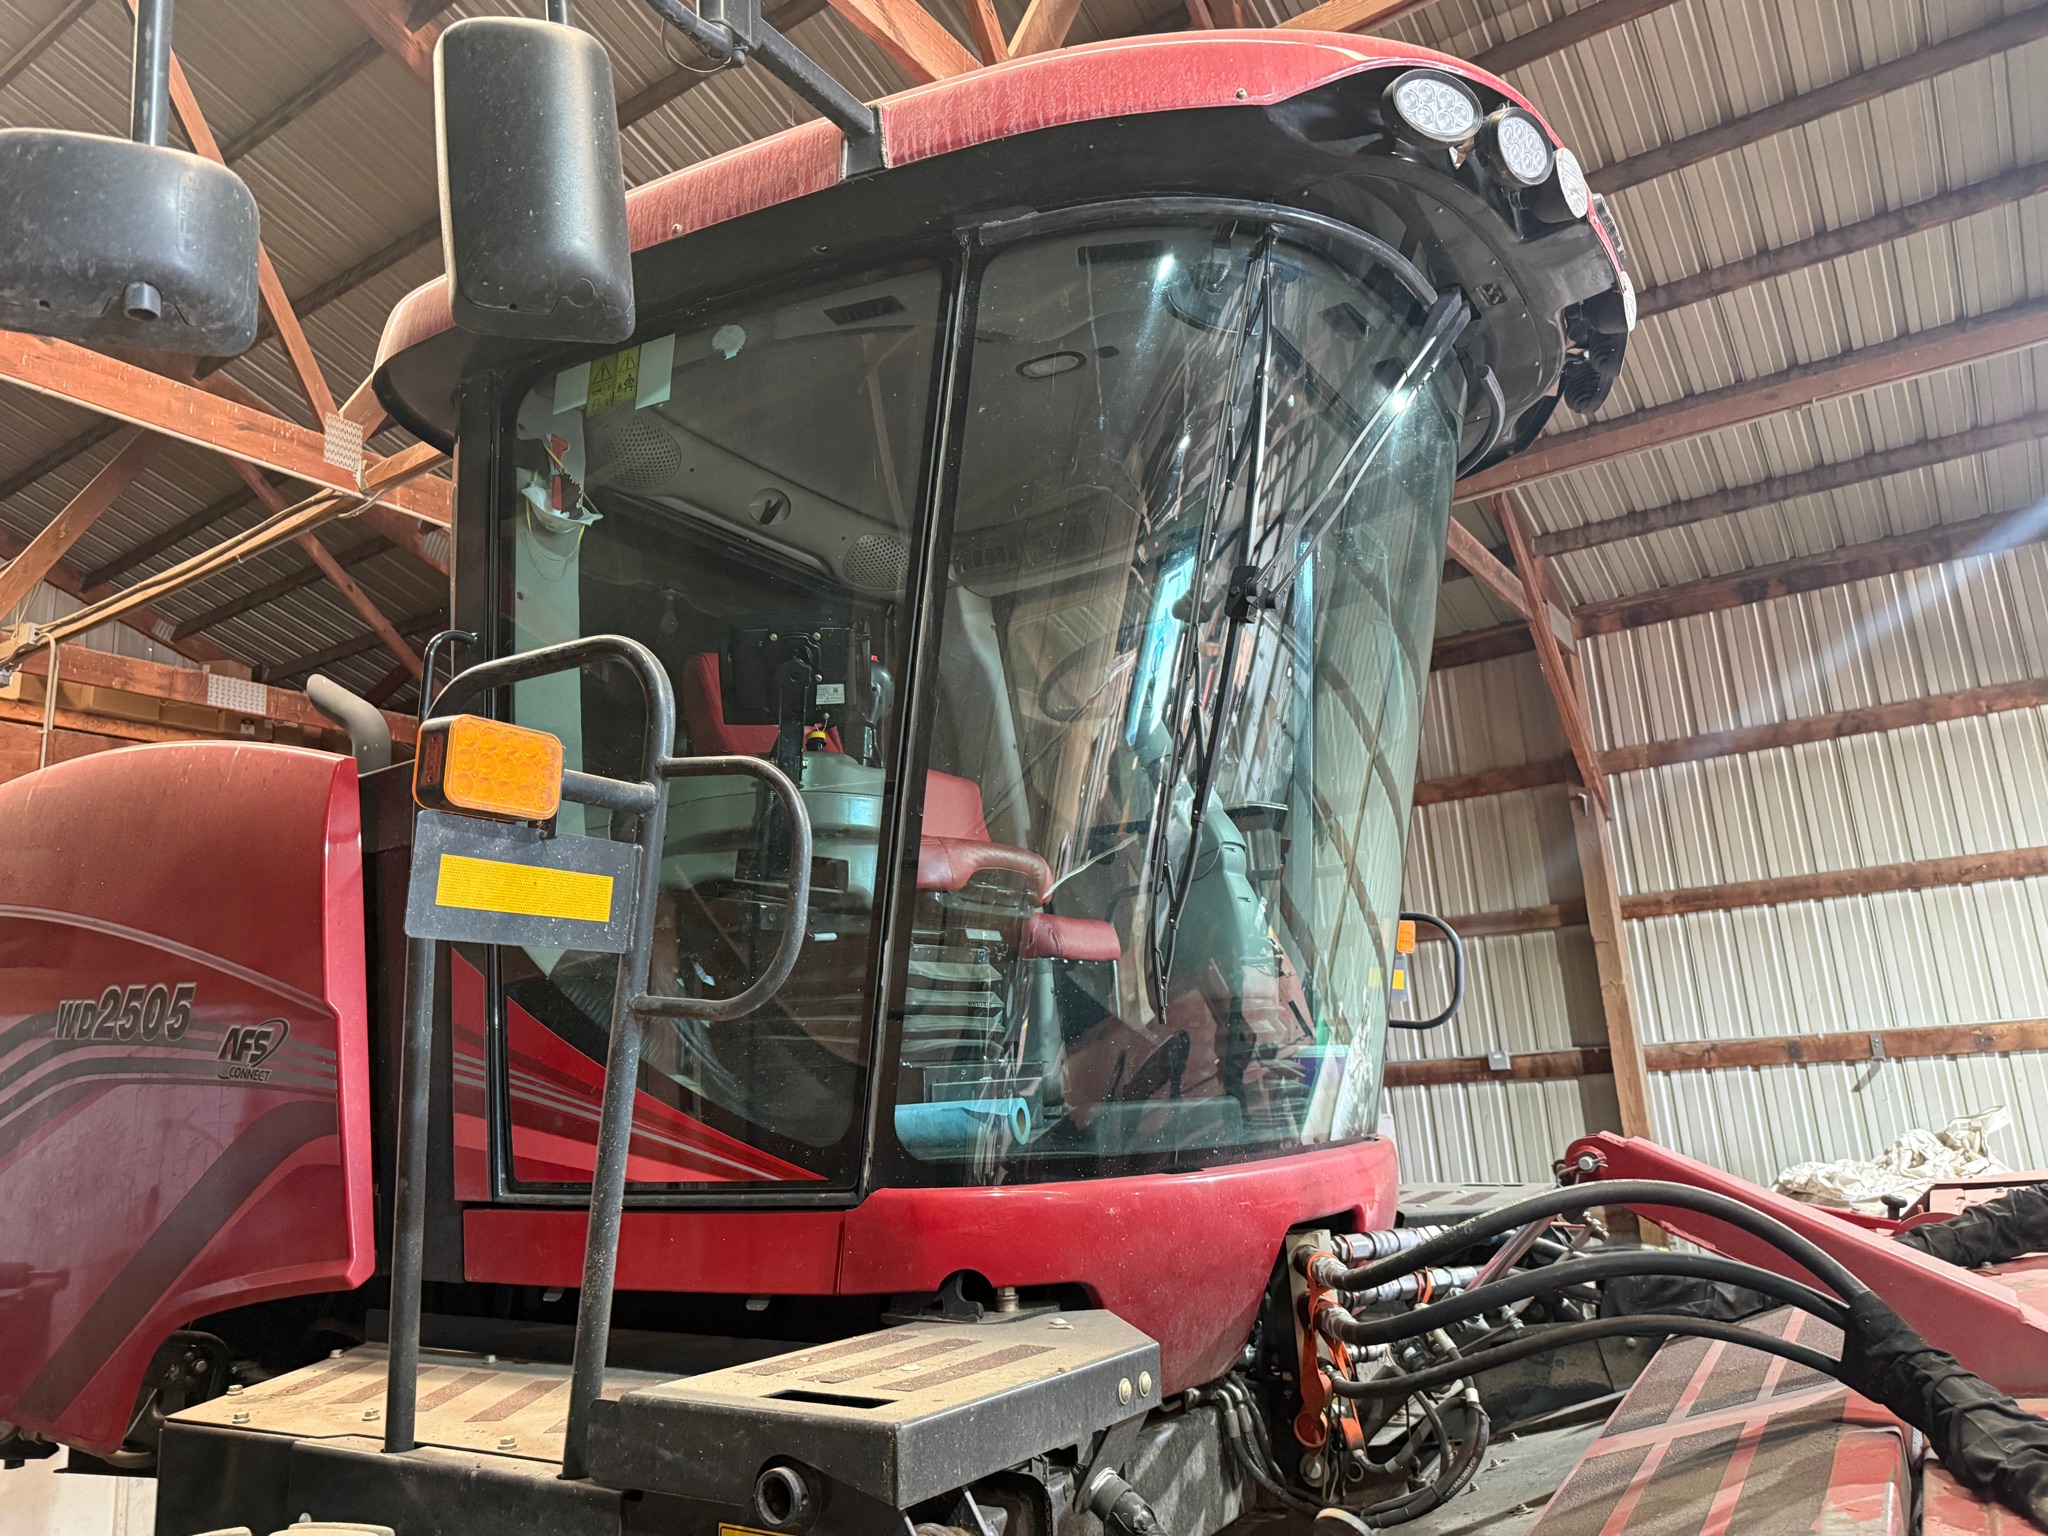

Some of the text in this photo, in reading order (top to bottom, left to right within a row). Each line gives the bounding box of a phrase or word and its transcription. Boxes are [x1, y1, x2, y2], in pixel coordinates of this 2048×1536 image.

[55, 982, 197, 1041] WD2505
[216, 1025, 274, 1065] AFS
[228, 1066, 271, 1082] CONNECT
